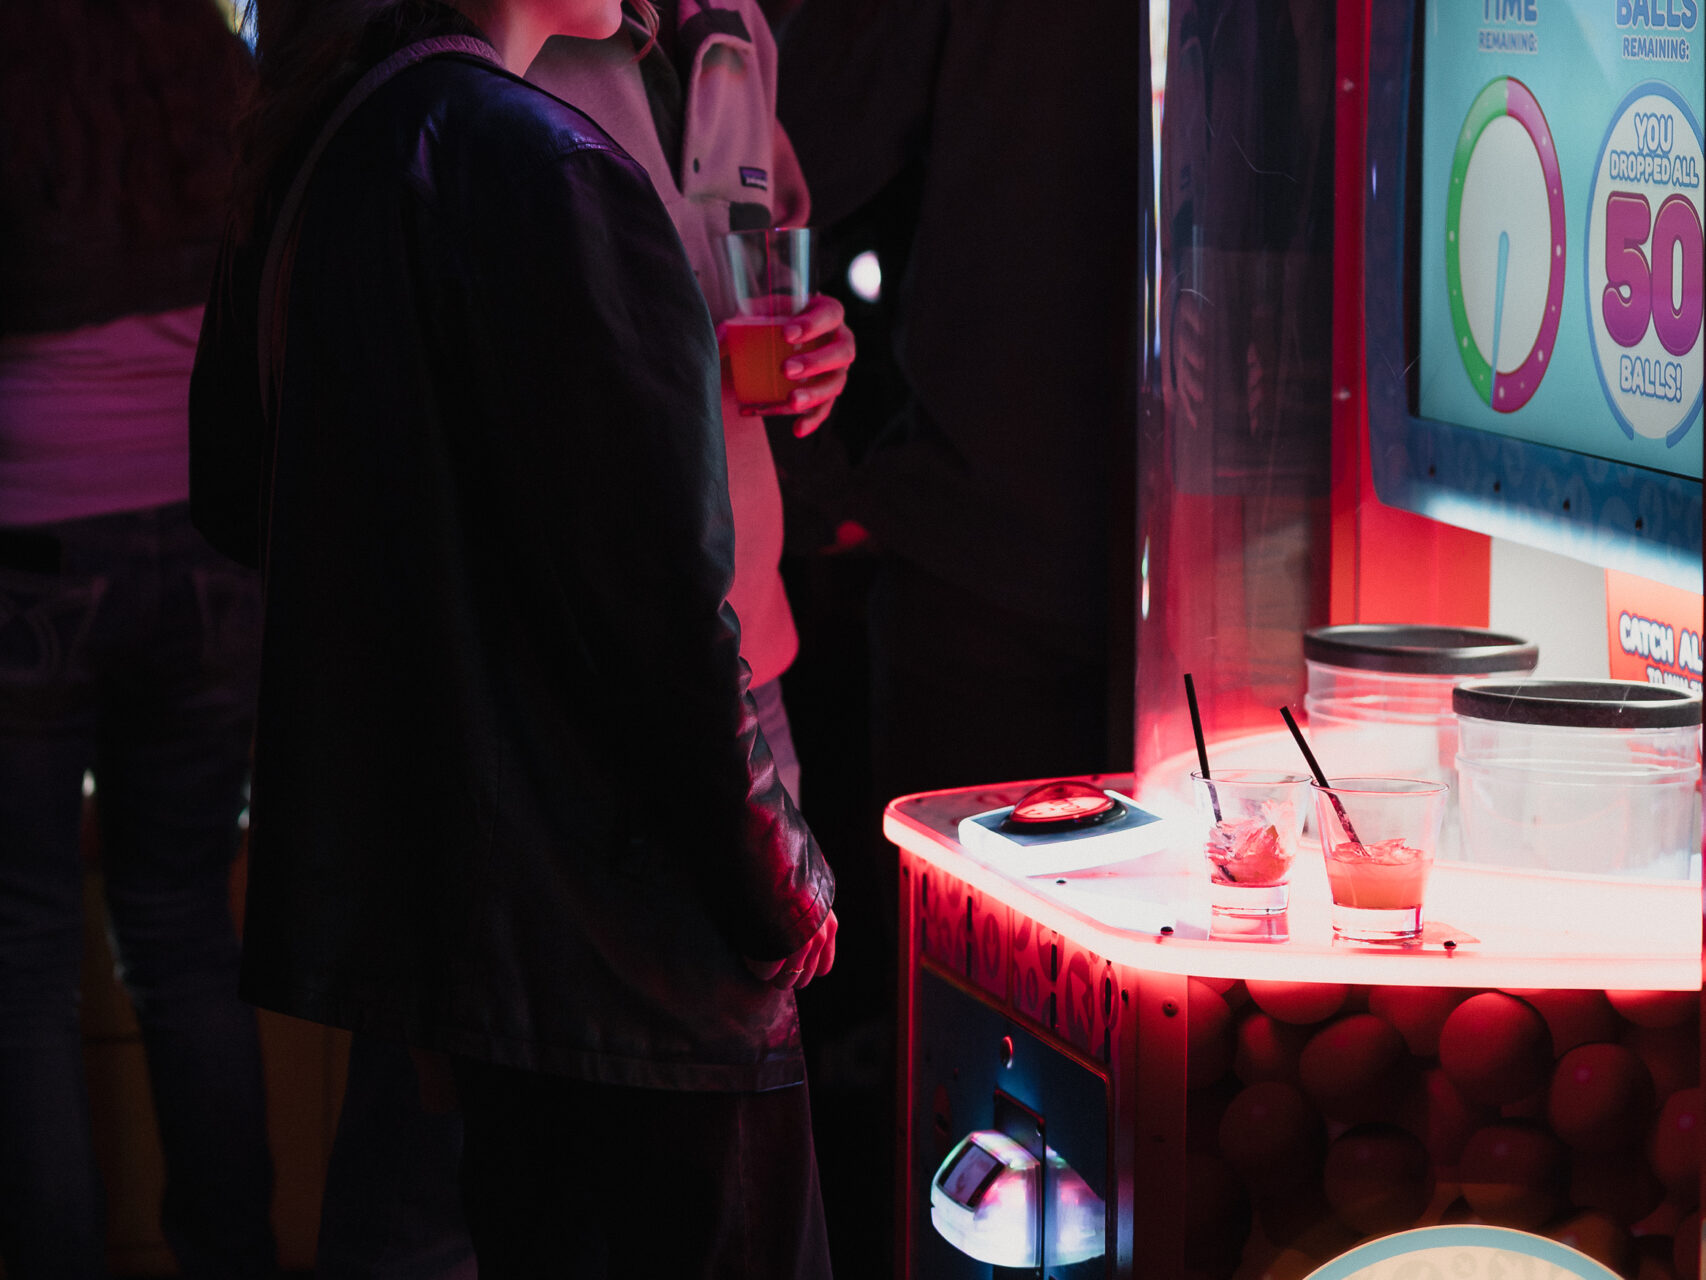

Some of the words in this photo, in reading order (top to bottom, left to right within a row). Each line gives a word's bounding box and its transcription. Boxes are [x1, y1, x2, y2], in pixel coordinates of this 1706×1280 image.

[1479, 31, 1538, 52] REMAINING:
[1622, 37, 1690, 61] REMAINING:
[1634, 112, 1673, 155] YOU
[1610, 150, 1671, 185] DROPPED
[1672, 155, 1699, 187] ALL
[1602, 191, 1705, 357] 50
[1620, 355, 1682, 402] BALLS!
[1620, 612, 1674, 667] CATCH
